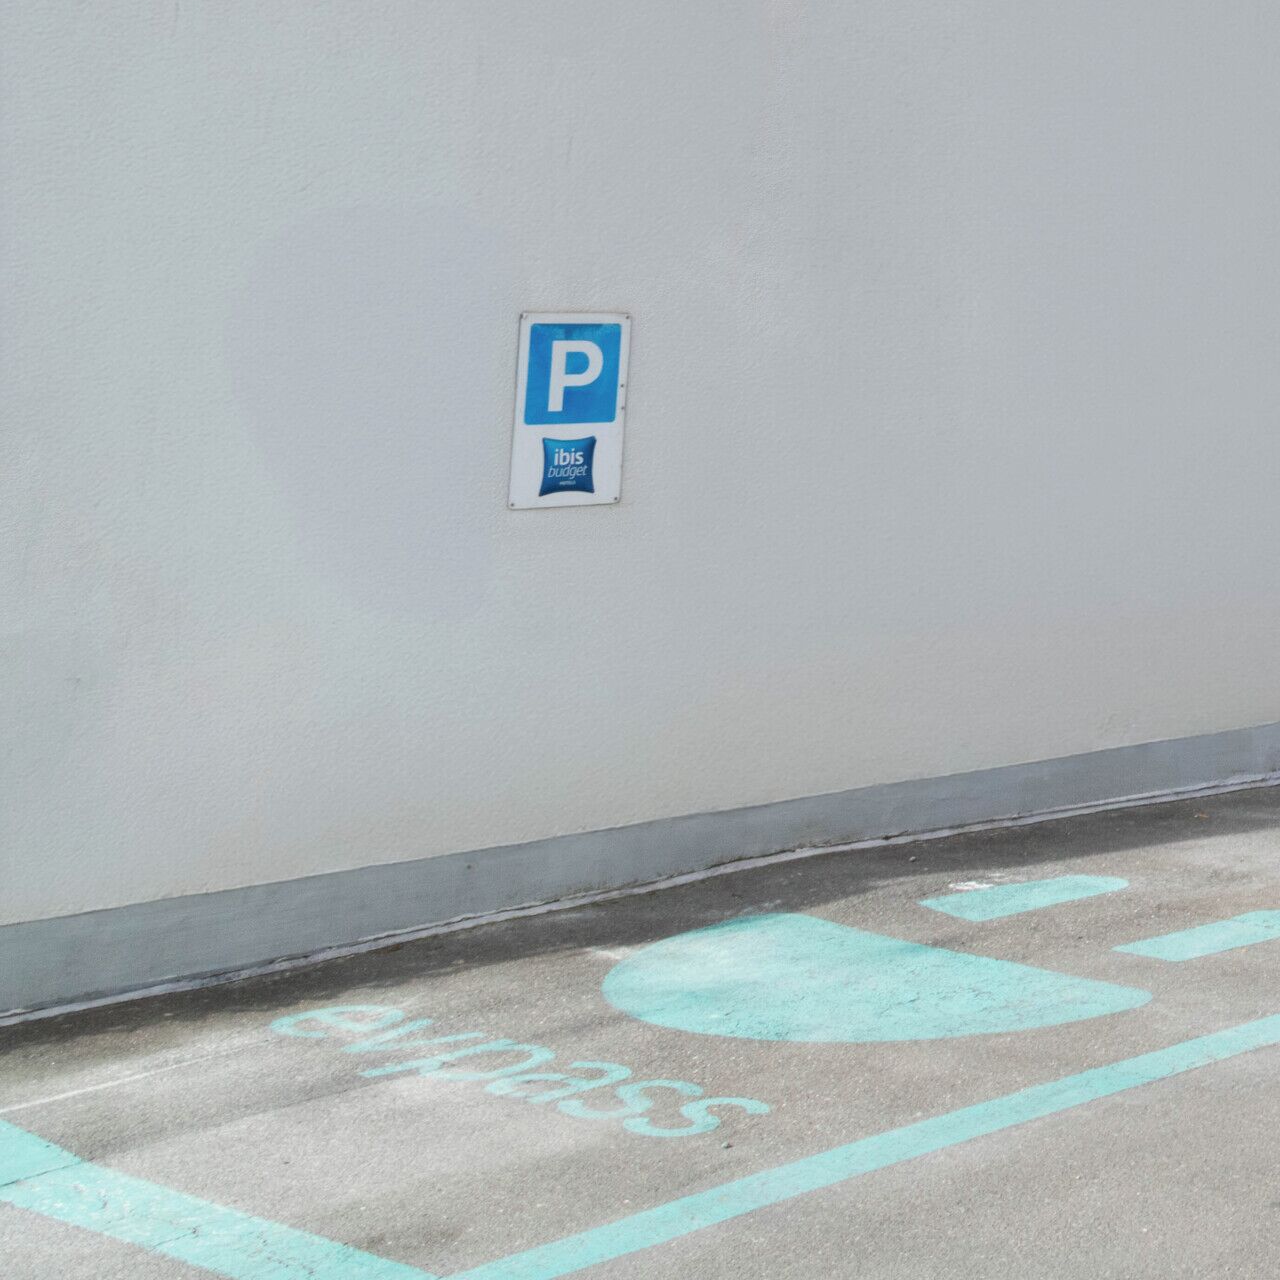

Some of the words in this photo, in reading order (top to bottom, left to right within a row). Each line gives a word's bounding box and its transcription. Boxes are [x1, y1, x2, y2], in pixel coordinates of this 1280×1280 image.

[547, 340, 604, 412] P
[548, 465, 588, 479] budget
[554, 448, 584, 465] ibis
[270, 1004, 771, 1138] evpass
